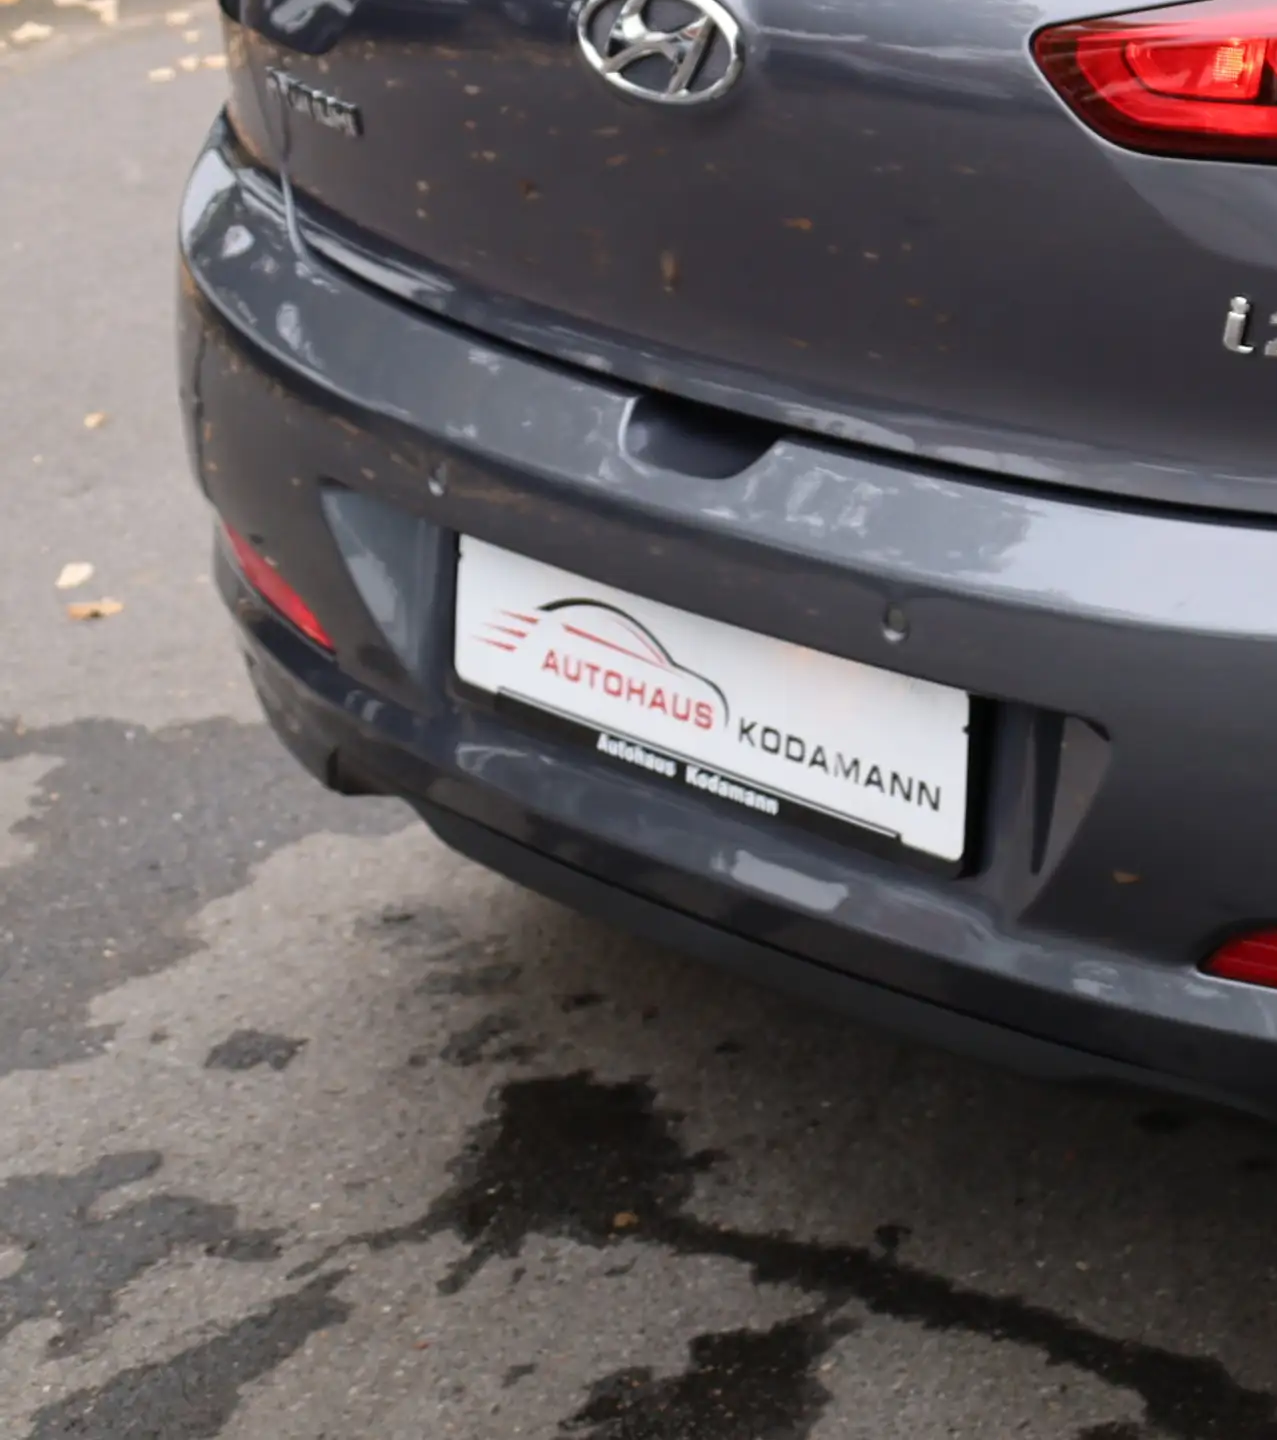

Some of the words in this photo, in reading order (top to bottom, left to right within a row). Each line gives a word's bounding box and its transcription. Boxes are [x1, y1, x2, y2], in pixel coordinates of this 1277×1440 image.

[541, 649, 714, 729] AUTOHAUS
[738, 717, 941, 811] KODAMANN
[596, 733, 677, 777] Autohaus
[685, 765, 780, 815] Kodamann
